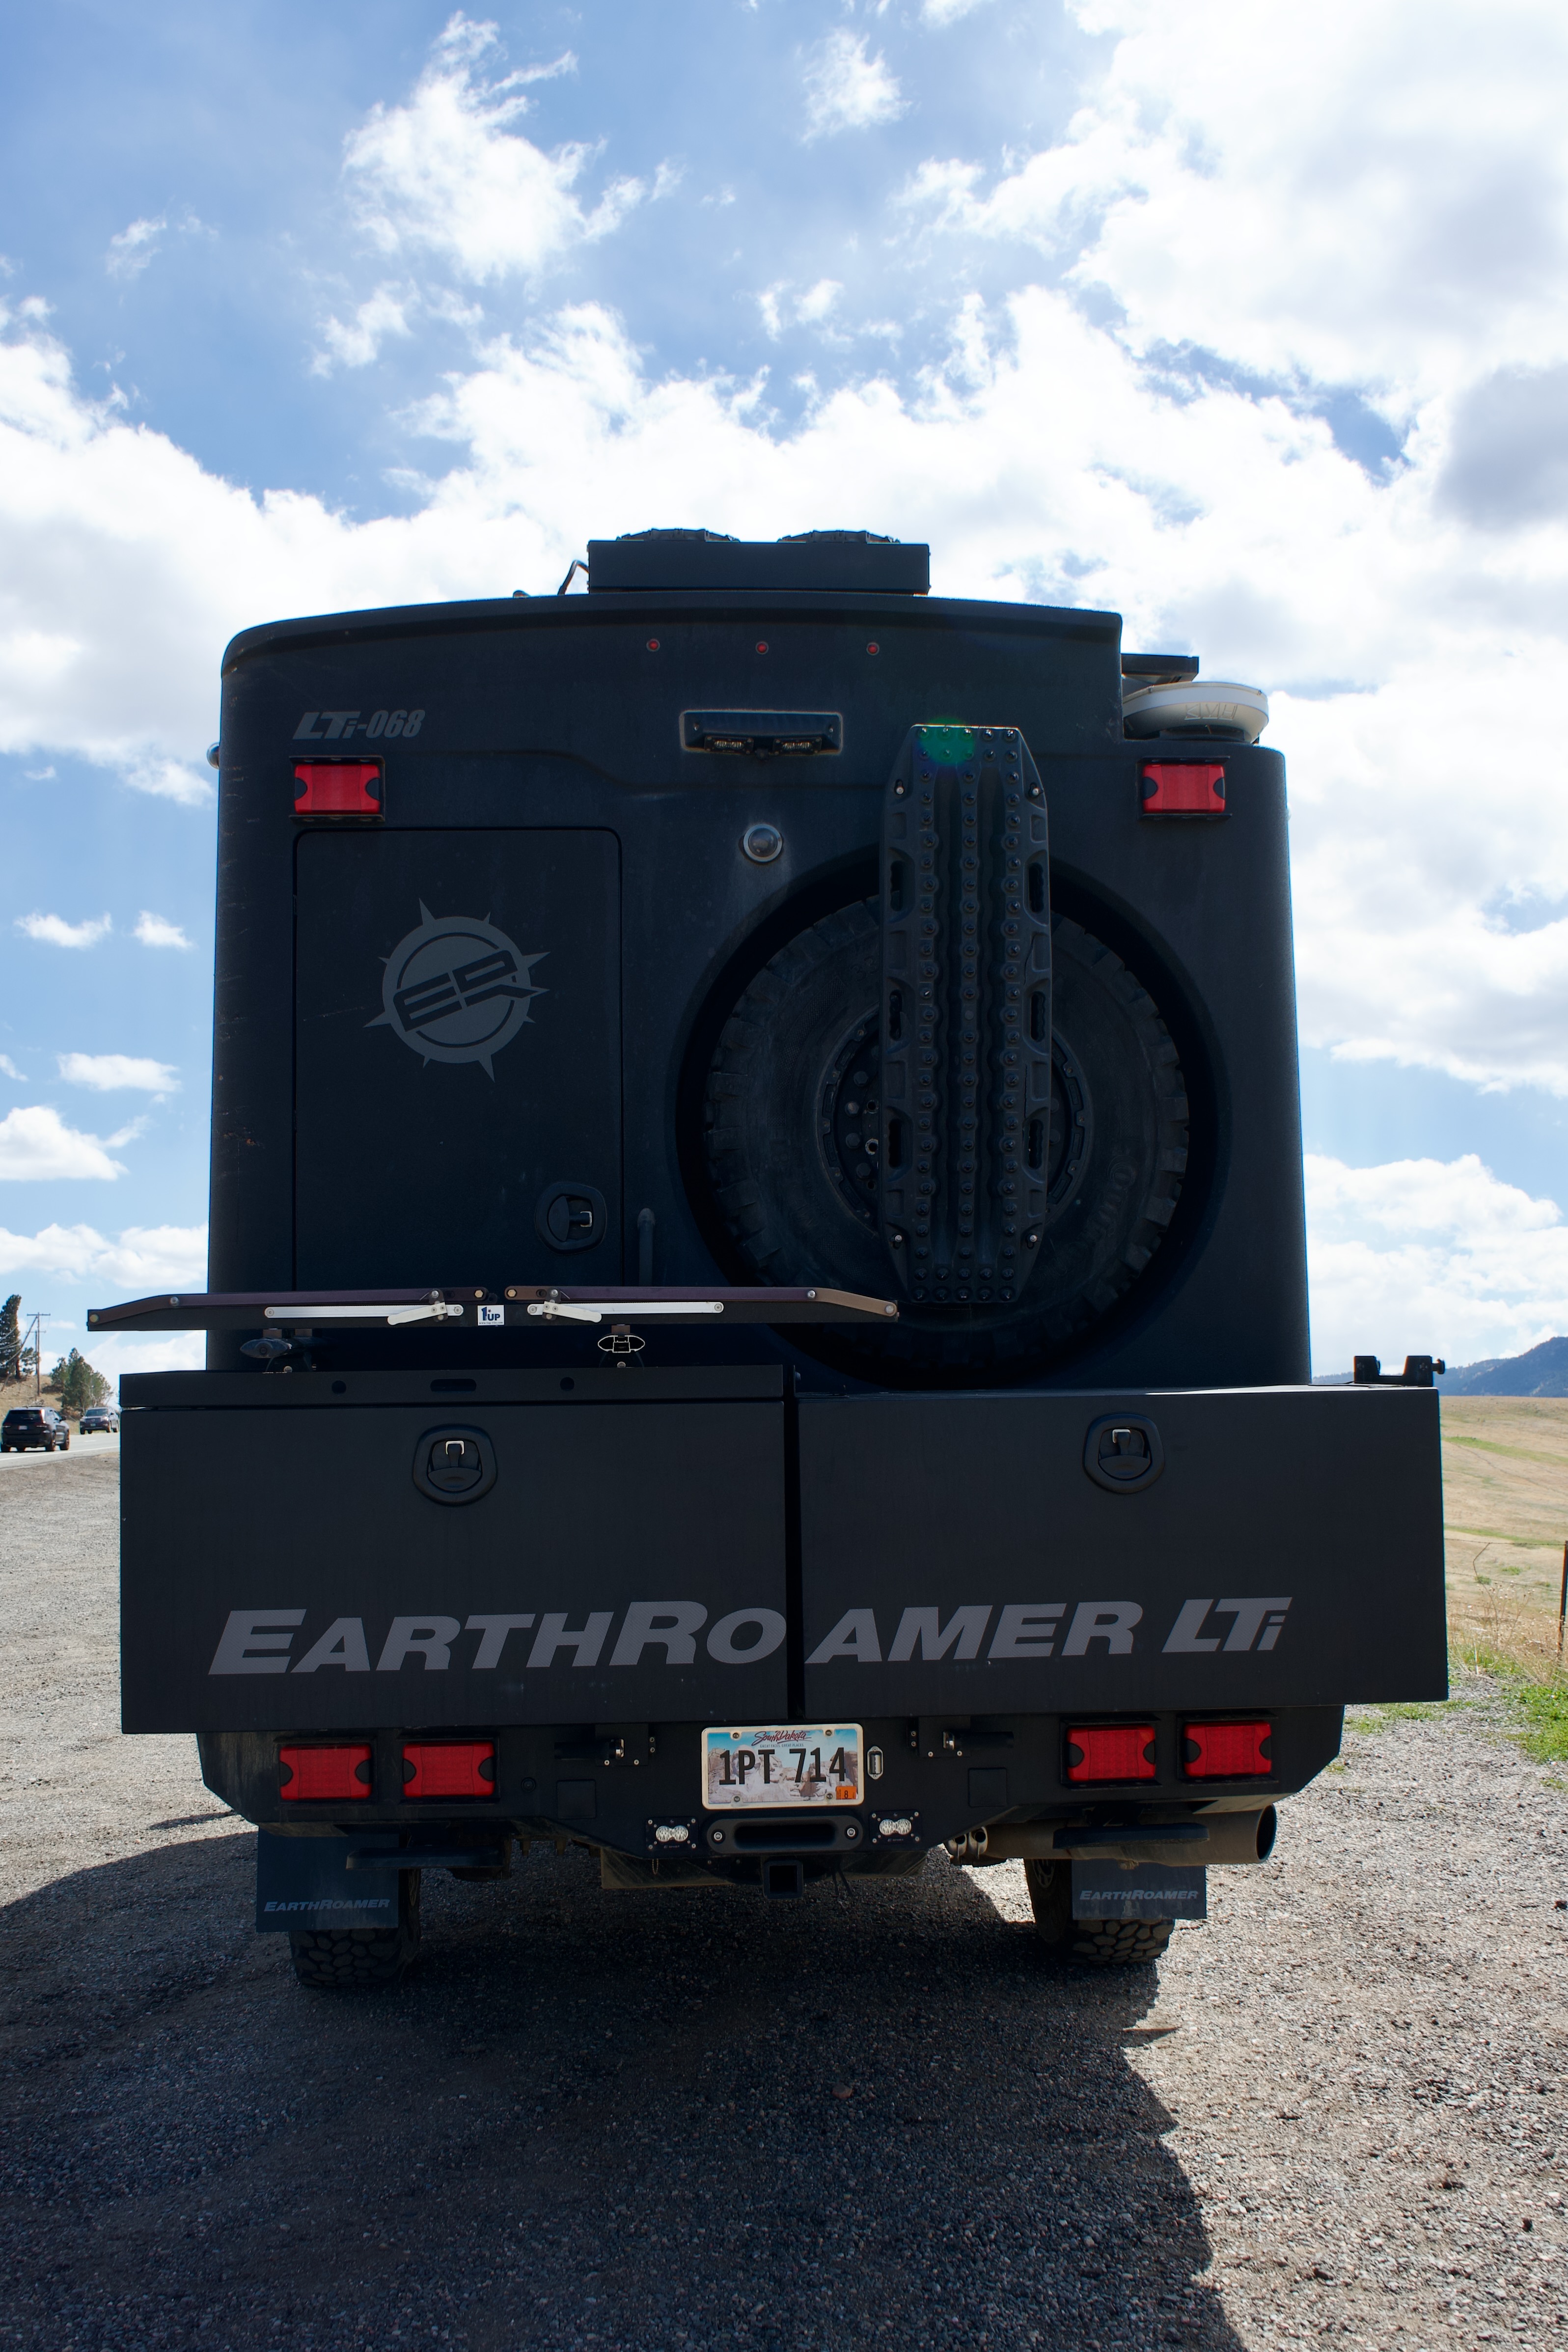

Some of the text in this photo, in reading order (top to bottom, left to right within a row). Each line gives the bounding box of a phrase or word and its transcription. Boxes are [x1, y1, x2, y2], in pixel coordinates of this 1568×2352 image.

[292, 709, 425, 740] LTi-068
[1184, 703, 1238, 720] KVH
[719, 1747, 846, 1785] 1PT 714
